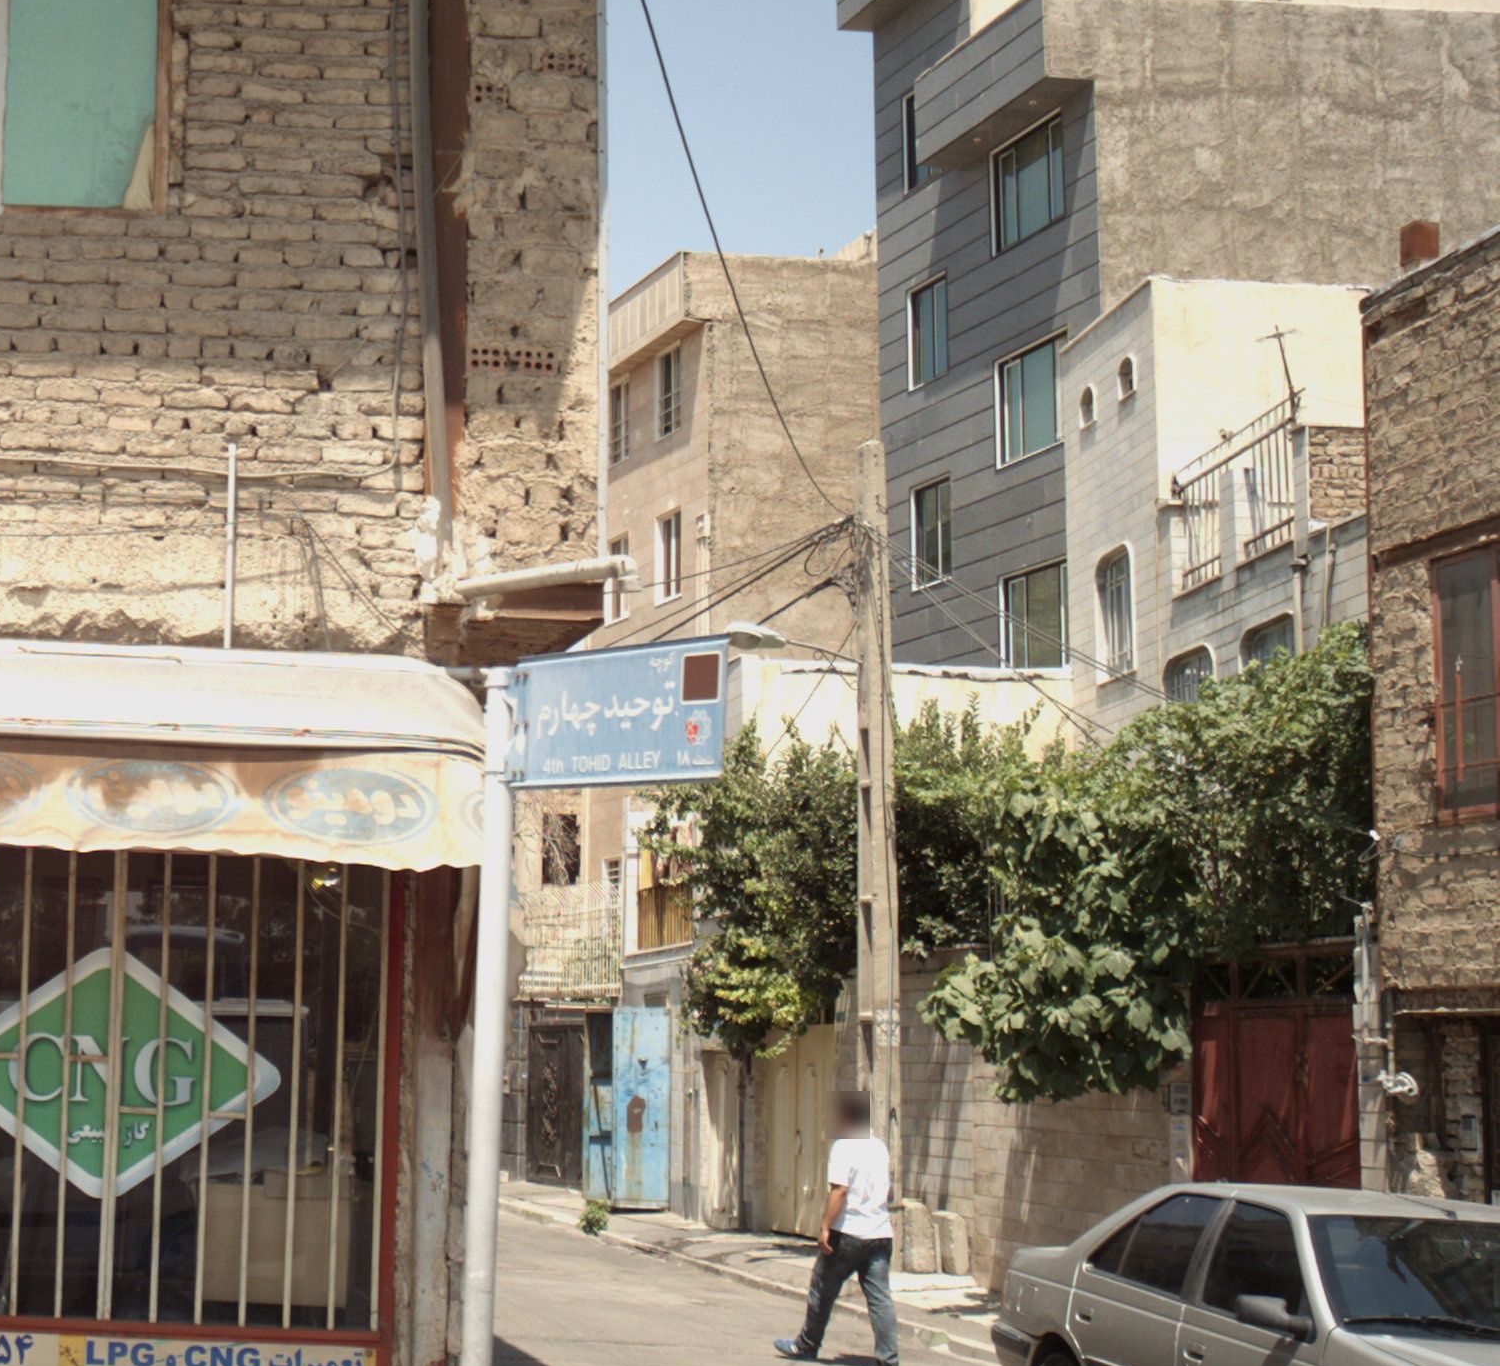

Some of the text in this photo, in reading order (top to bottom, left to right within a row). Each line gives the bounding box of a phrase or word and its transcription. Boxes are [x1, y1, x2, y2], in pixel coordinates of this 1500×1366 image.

[648, 652, 676, 673] کوچه
[535, 681, 676, 739] توحید چهارم
[542, 750, 661, 775] 4th TOHID ALLEY
[286, 778, 421, 825] دومینو
[8, 1031, 197, 1107] CNG
[67, 1123, 110, 1145] بیعی
